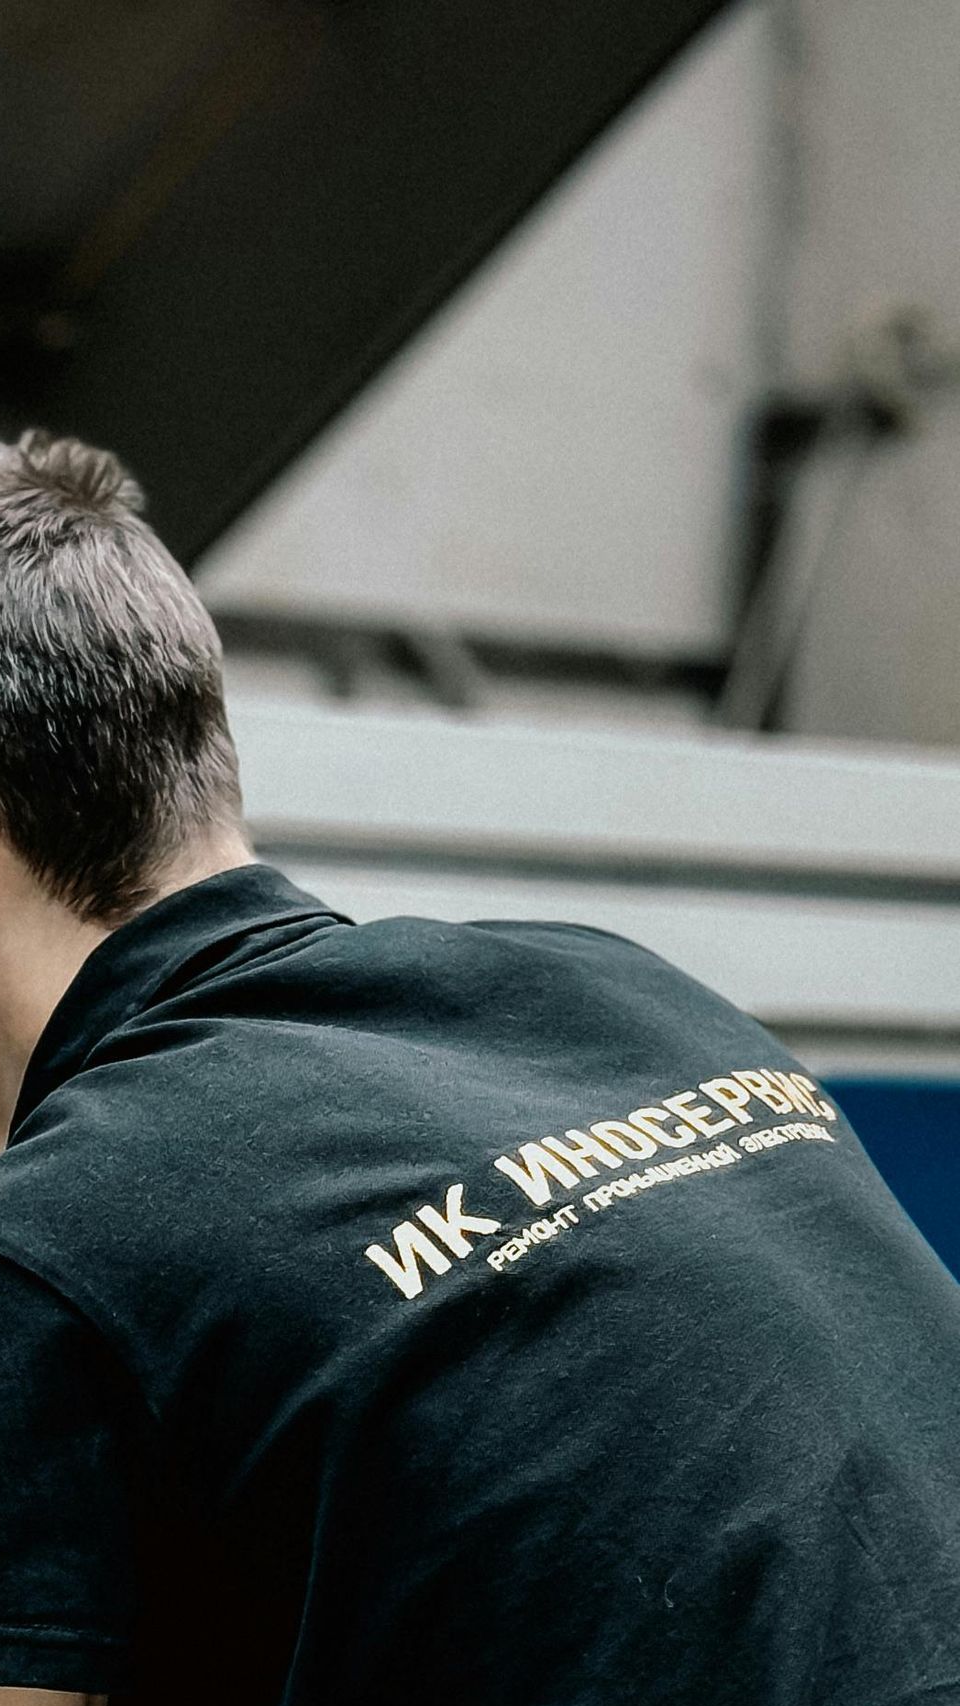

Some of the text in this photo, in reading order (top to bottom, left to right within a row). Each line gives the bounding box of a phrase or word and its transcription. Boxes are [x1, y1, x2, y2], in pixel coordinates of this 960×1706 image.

[365, 1068, 837, 1300] ИК ИНОСЕРВИС
[486, 1204, 579, 1271] РЕМОНТ
